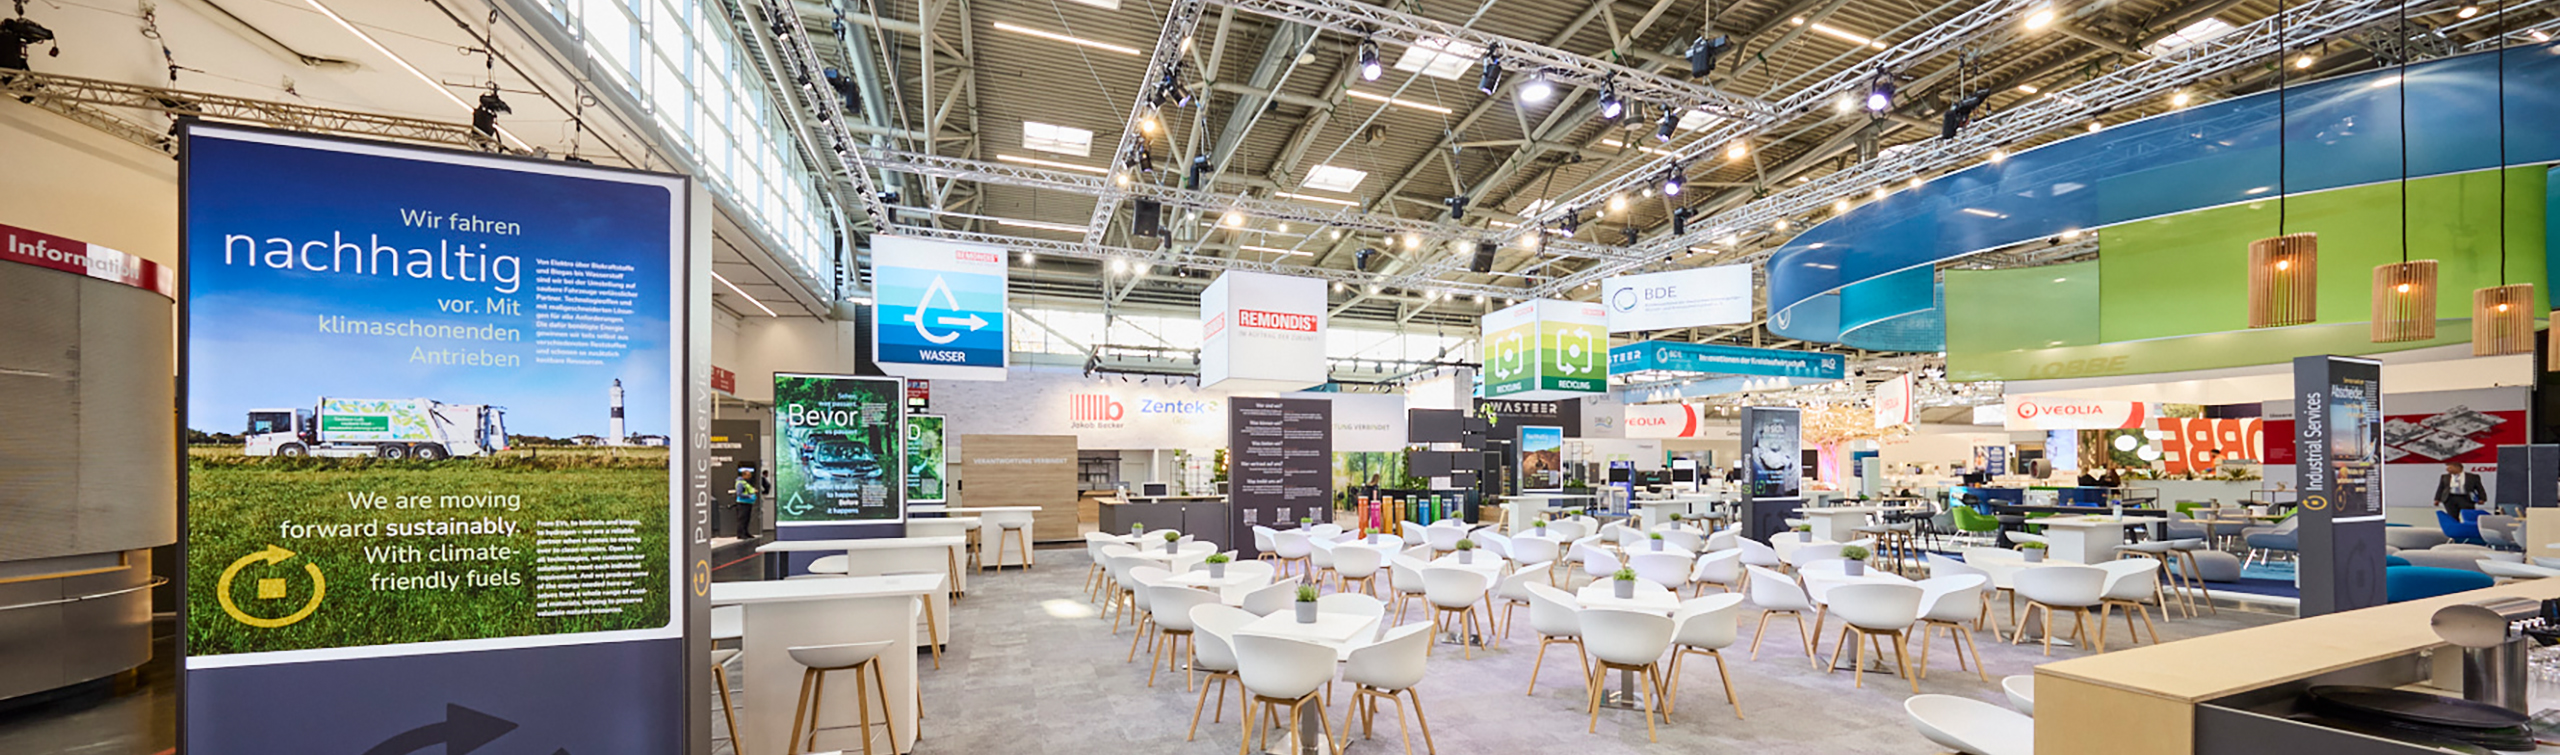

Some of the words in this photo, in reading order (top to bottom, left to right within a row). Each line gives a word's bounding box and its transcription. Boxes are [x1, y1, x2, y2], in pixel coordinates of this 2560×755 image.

[400, 208, 442, 229] Wir
[449, 213, 520, 235] fahren
[9, 234, 140, 280] Information
[225, 230, 520, 293] nachhaltig
[1645, 286, 1677, 300] BDE
[437, 297, 478, 314] vor.
[486, 297, 521, 316] Mit
[318, 314, 520, 341] klimaschonenden
[409, 346, 520, 367] Antrieben
[919, 350, 966, 362] WASSER
[2029, 355, 2129, 379] LOBBE
[788, 403, 858, 427] Bevor
[1141, 399, 1205, 414] Zentek
[2041, 405, 2103, 416] VEOLIA
[2304, 391, 2322, 438] Services
[2305, 439, 2323, 491] Industrial
[348, 491, 388, 510] We
[395, 494, 432, 510] are
[440, 491, 521, 512] moving
[694, 458, 708, 544] Public
[280, 519, 378, 538] forward
[386, 516, 521, 537] sustainably.
[364, 545, 421, 564] With
[428, 543, 521, 563] climate-
[370, 570, 460, 592] friendly
[466, 568, 521, 588] fuels
